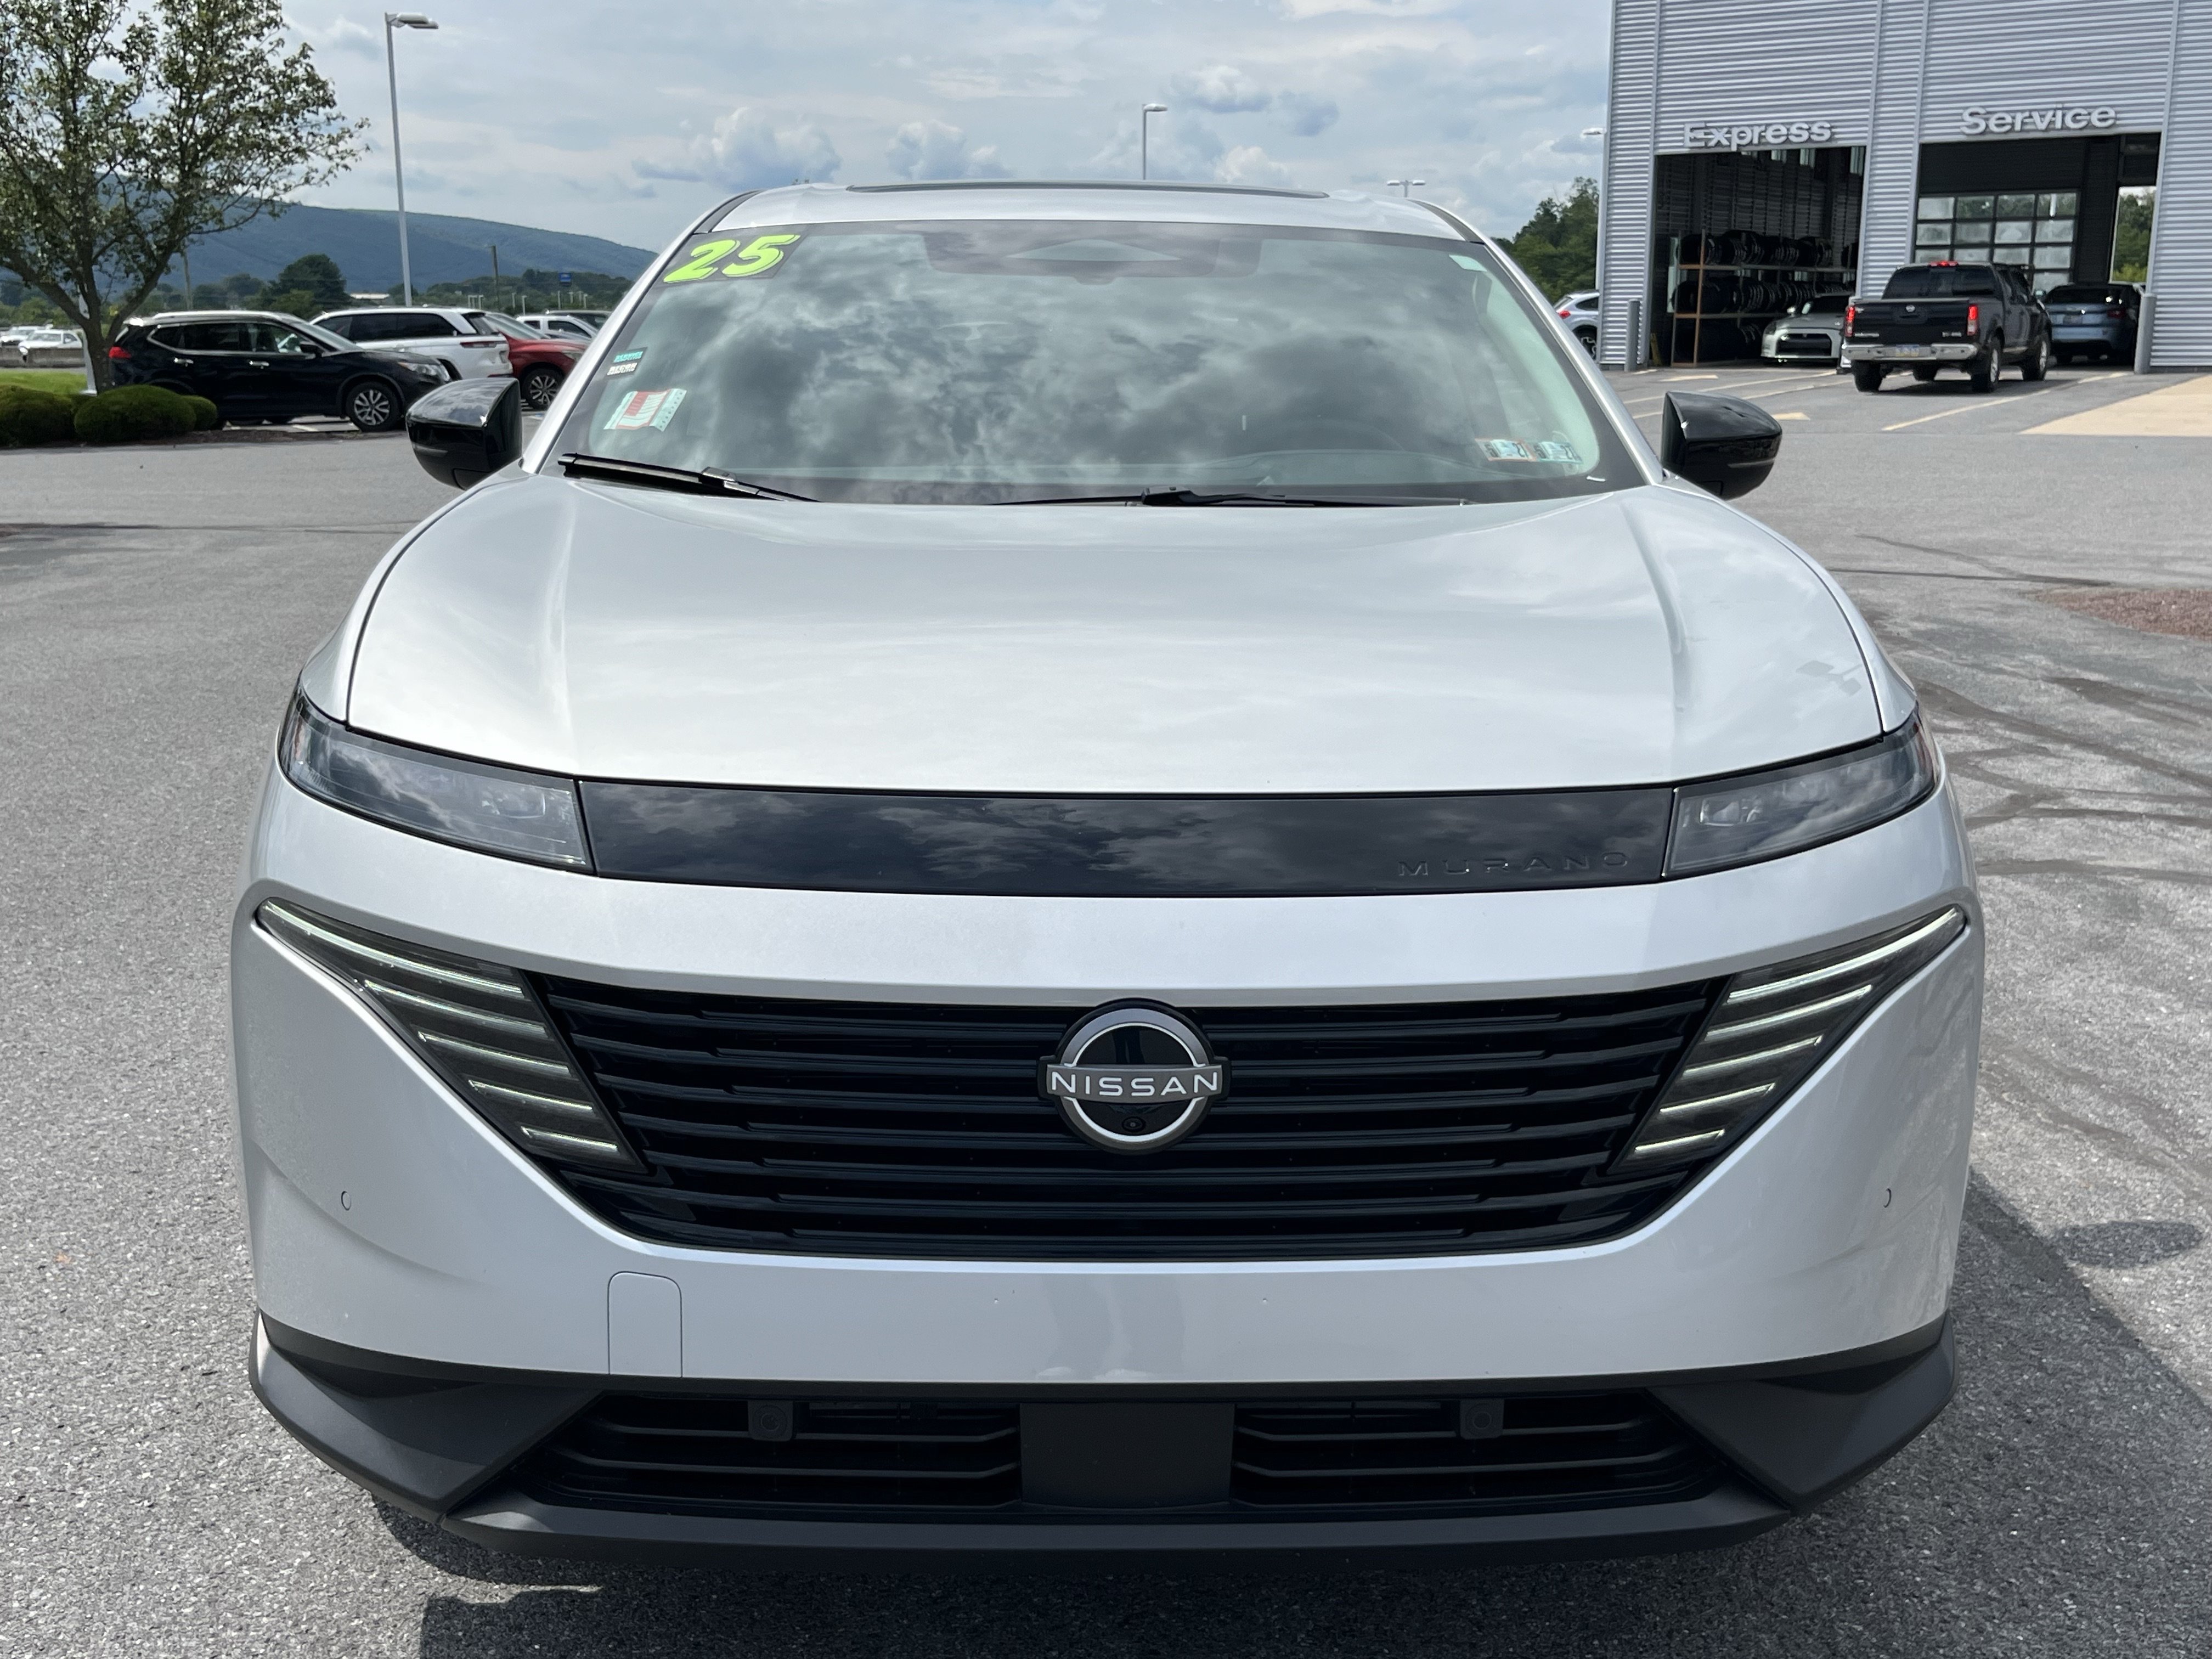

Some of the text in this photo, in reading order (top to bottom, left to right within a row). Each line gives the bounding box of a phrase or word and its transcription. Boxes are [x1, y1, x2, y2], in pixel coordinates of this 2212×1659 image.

[1683, 103, 2117, 152] Express Service
[663, 234, 802, 284] 25
[1398, 851, 1628, 876] MURANO
[1051, 1070, 1218, 1097] NISSAN
